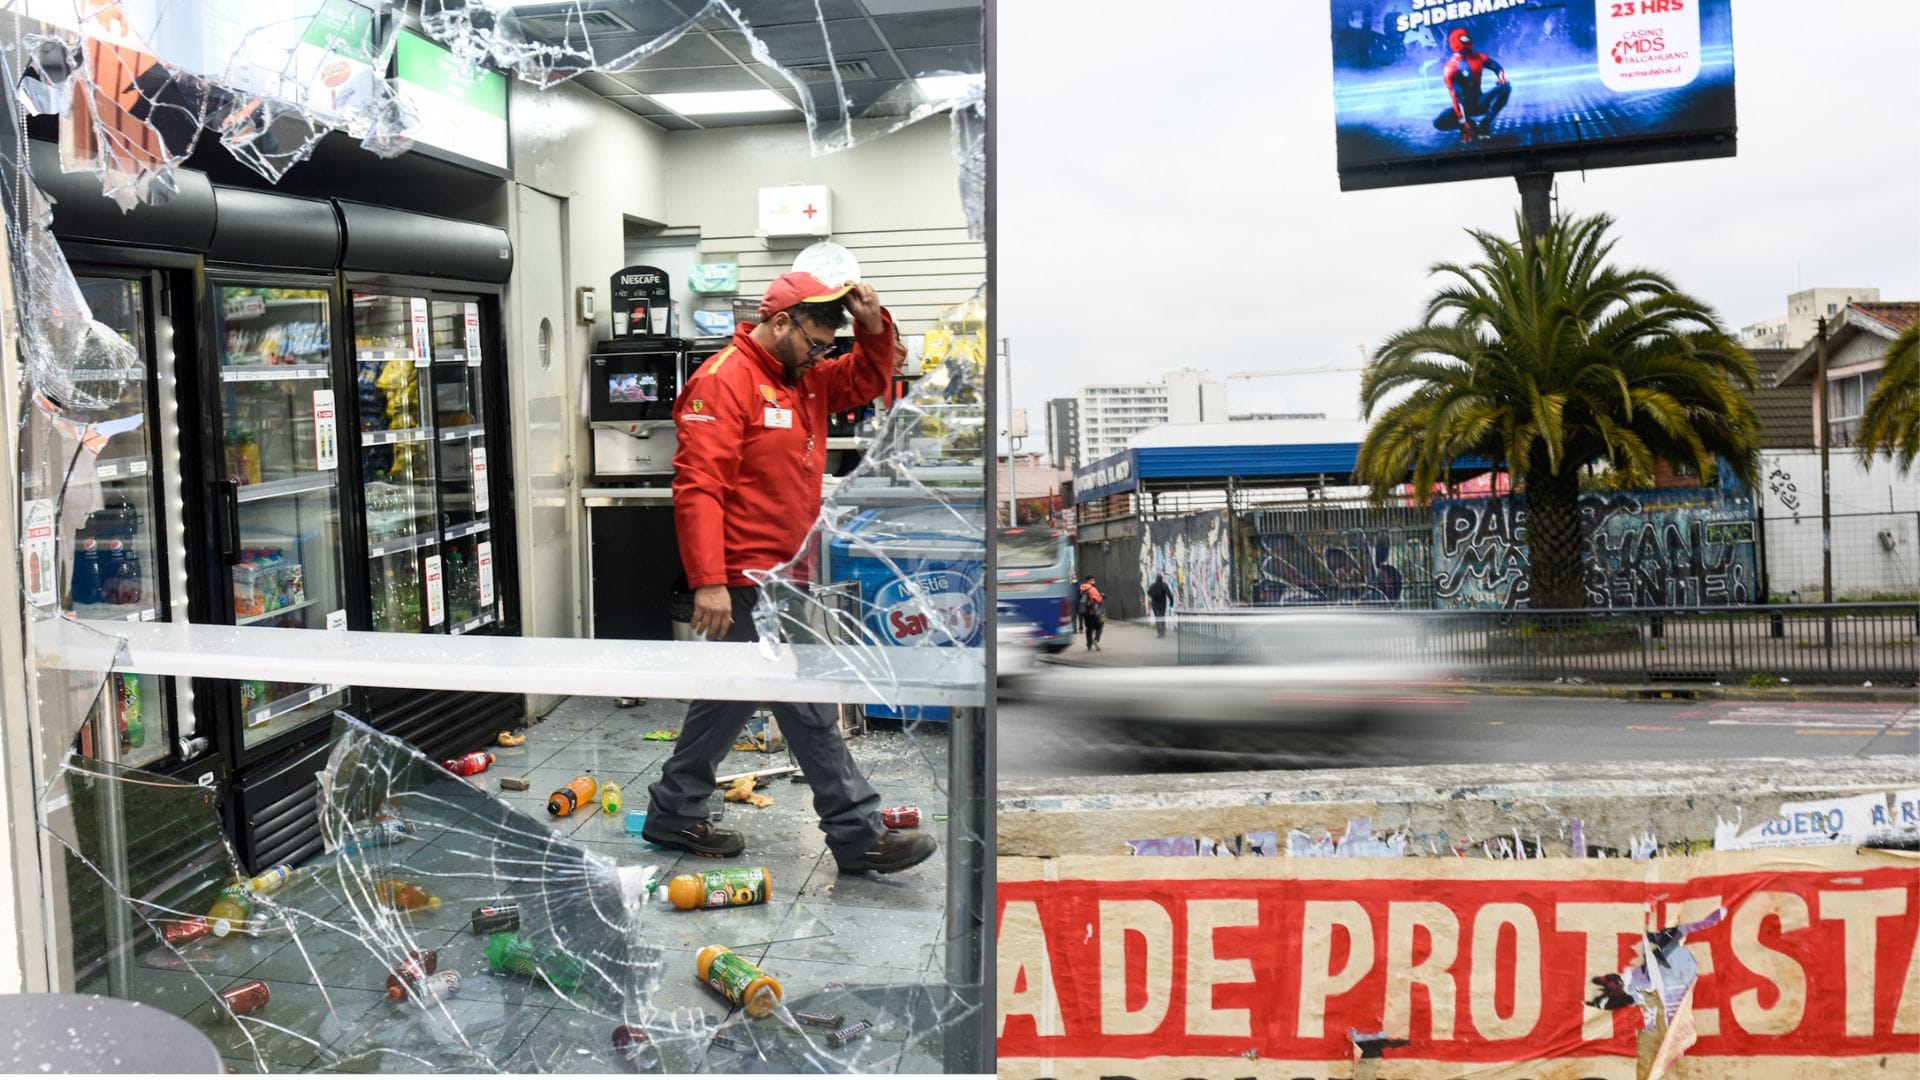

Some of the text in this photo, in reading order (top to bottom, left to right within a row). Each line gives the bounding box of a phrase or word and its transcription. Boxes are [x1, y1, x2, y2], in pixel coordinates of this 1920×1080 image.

[1396, 0, 1527, 32] SPIDERMA
[1611, 0, 1684, 17] 23 HRS
[1623, 27, 1664, 40] CASINO
[1623, 37, 1665, 54] MDS
[1624, 50, 1689, 64] TALCAHUANO
[1902, 800, 1920, 823] R
[1099, 898, 1260, 1037] DE
[1297, 886, 1920, 1041] PROTEST
